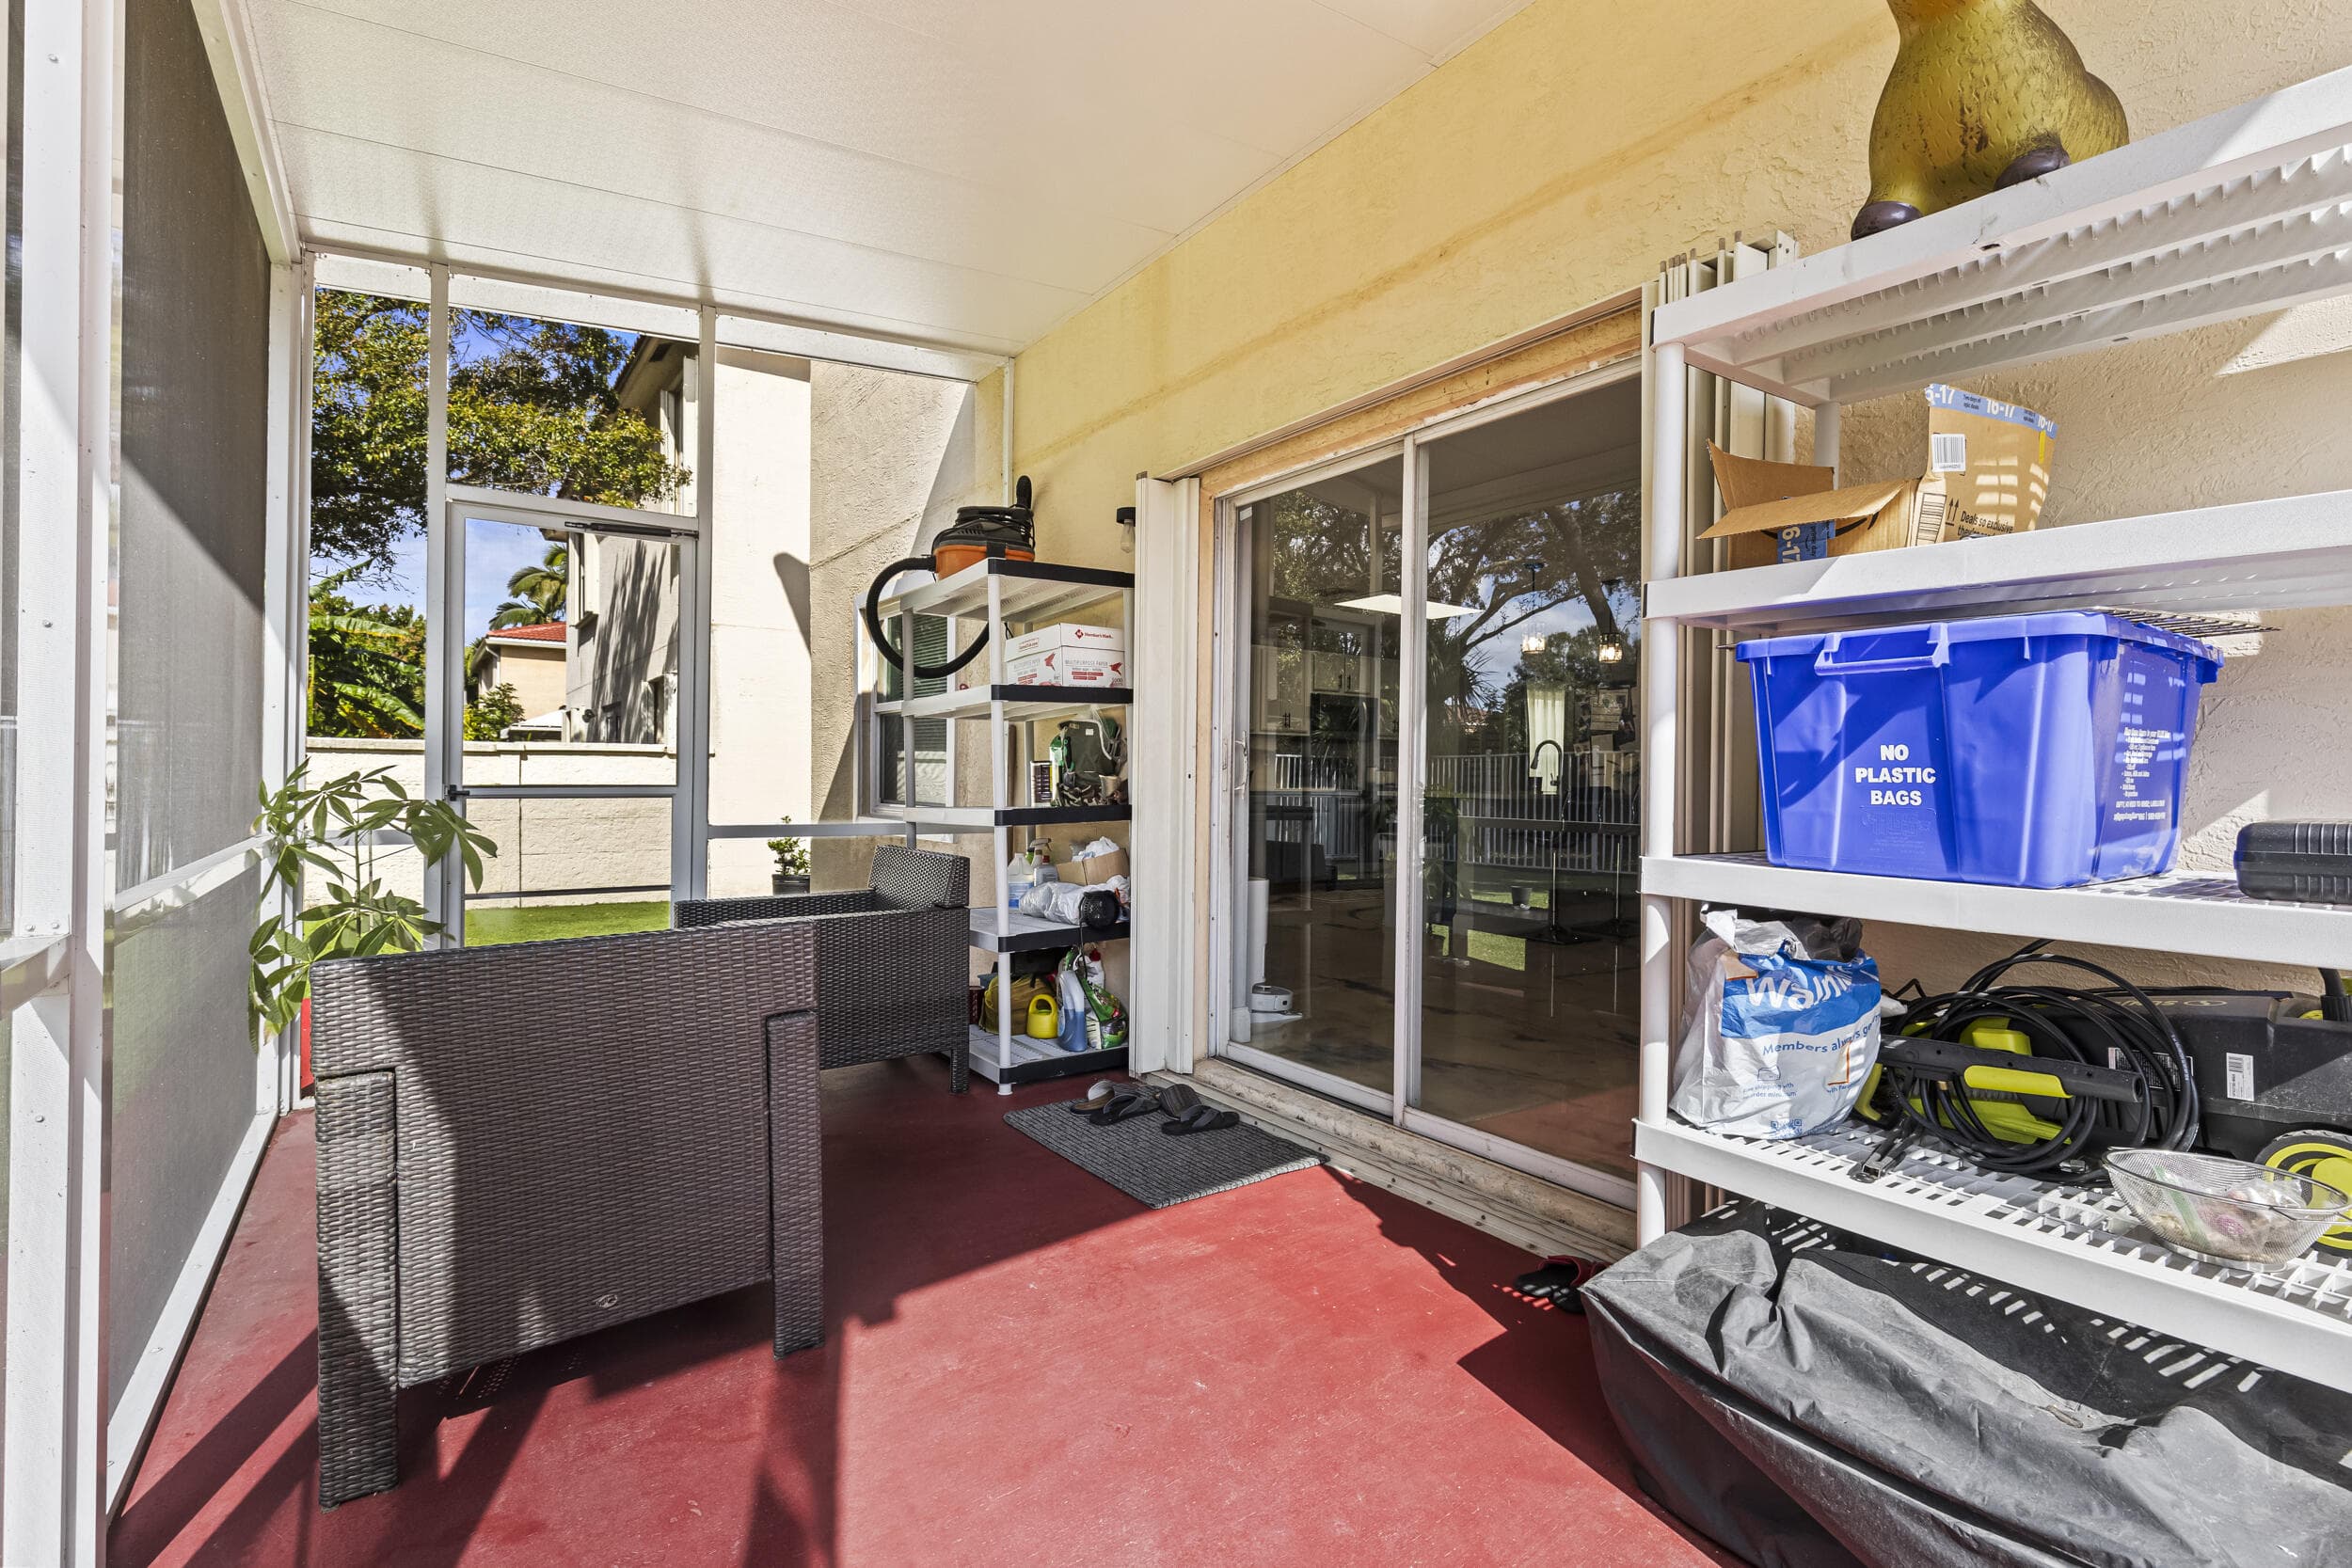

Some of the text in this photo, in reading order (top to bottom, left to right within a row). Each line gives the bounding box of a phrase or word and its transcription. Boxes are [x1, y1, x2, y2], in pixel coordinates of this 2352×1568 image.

[1961, 510, 2013, 533] Deals so exclusive
[1880, 744, 1910, 761] NO
[1855, 768, 1936, 784] PLASTIC
[1870, 790, 1922, 806] BAGS
[1762, 1040, 1828, 1055] Members
